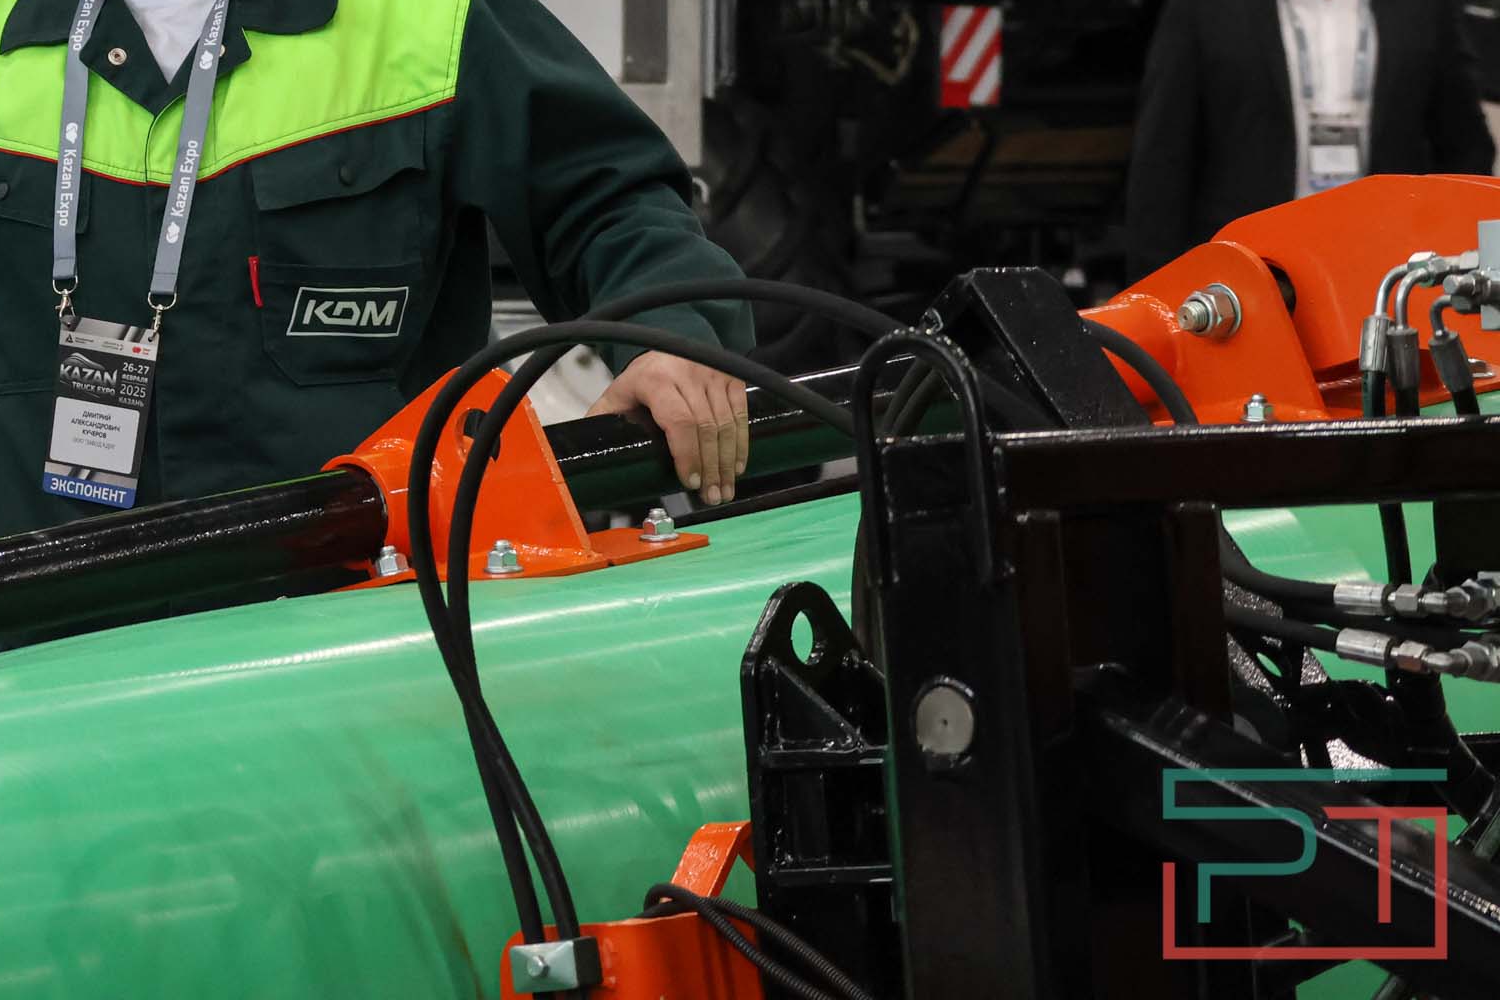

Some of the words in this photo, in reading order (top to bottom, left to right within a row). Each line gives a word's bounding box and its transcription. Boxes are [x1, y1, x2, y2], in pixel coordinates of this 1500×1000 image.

[71, 19, 90, 50] Expo
[203, 11, 224, 46] Kazan
[60, 149, 77, 189] Kazan
[180, 140, 200, 173] Expo
[56, 192, 73, 226] Expo
[170, 176, 191, 217] Kazan
[302, 299, 398, 327] KDM
[59, 364, 118, 386] KAZAN
[122, 362, 150, 375] 26-27
[71, 382, 96, 393] TRUCK
[119, 384, 146, 398] 2025
[50, 477, 128, 504] ЭКСПОНЕНТ
